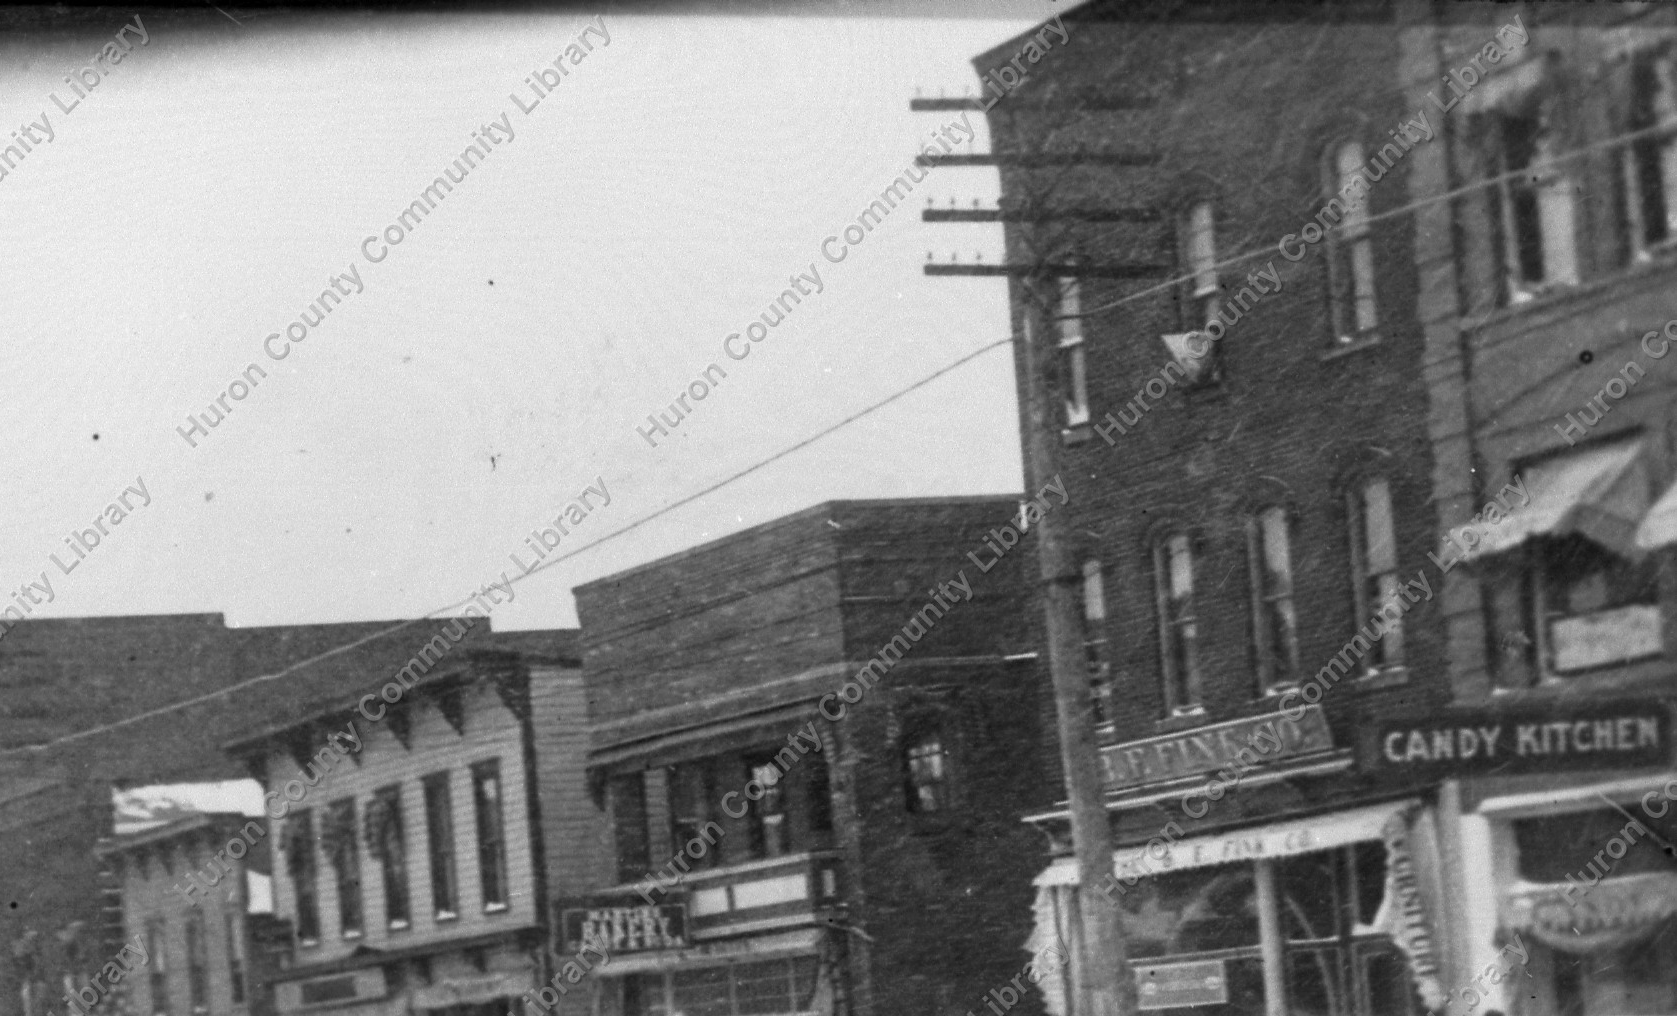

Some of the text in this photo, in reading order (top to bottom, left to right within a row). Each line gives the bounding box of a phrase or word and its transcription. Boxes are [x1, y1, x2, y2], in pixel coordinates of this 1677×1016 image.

[1384, 716, 1659, 763] CANDY KITCHEN
[582, 916, 671, 943] BAKERY
[1391, 838, 1438, 976] URNITUR
